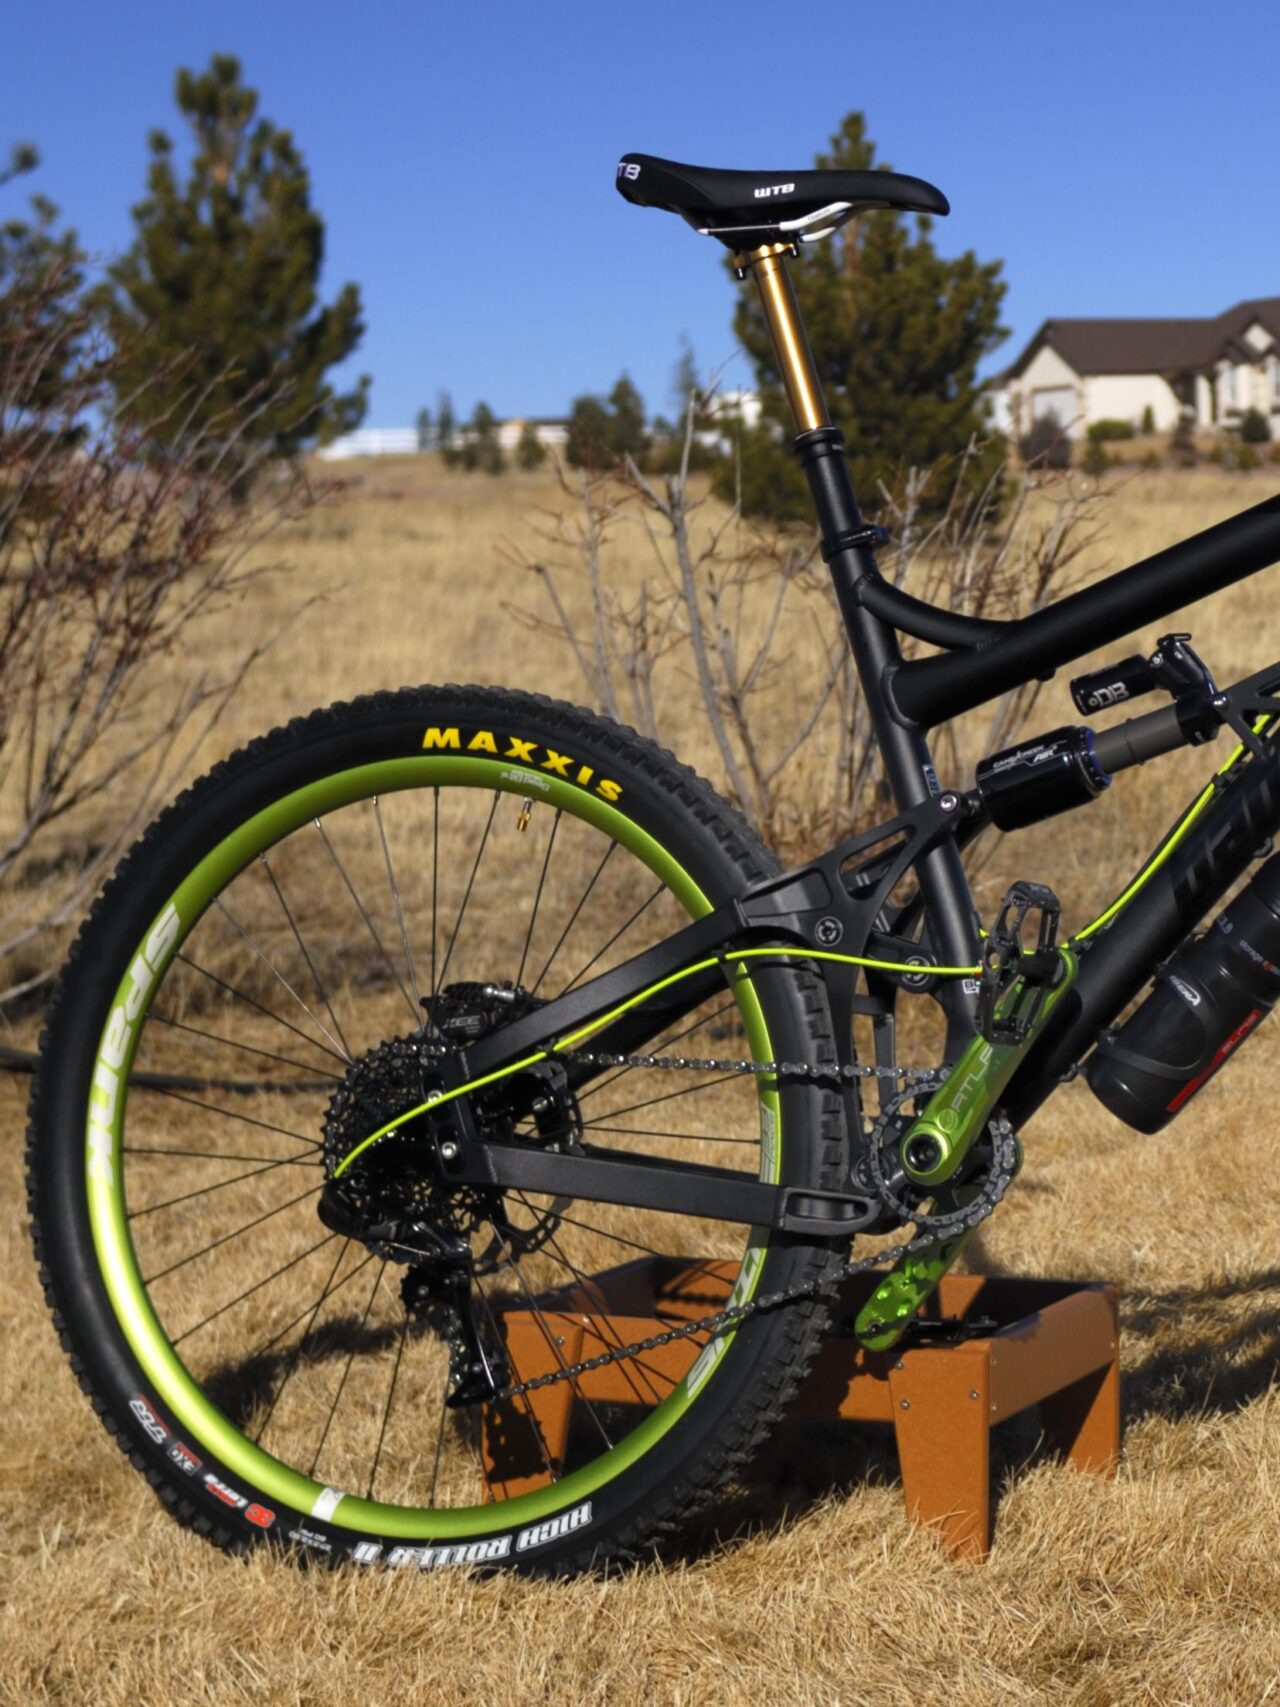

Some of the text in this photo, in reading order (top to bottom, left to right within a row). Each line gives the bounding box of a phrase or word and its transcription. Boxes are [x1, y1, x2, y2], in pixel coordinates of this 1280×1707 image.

[754, 182, 796, 198] WTB
[422, 727, 624, 801] MAXXIS
[518, 1501, 592, 1551] HIGH
[387, 1535, 513, 1569] ROLLER
